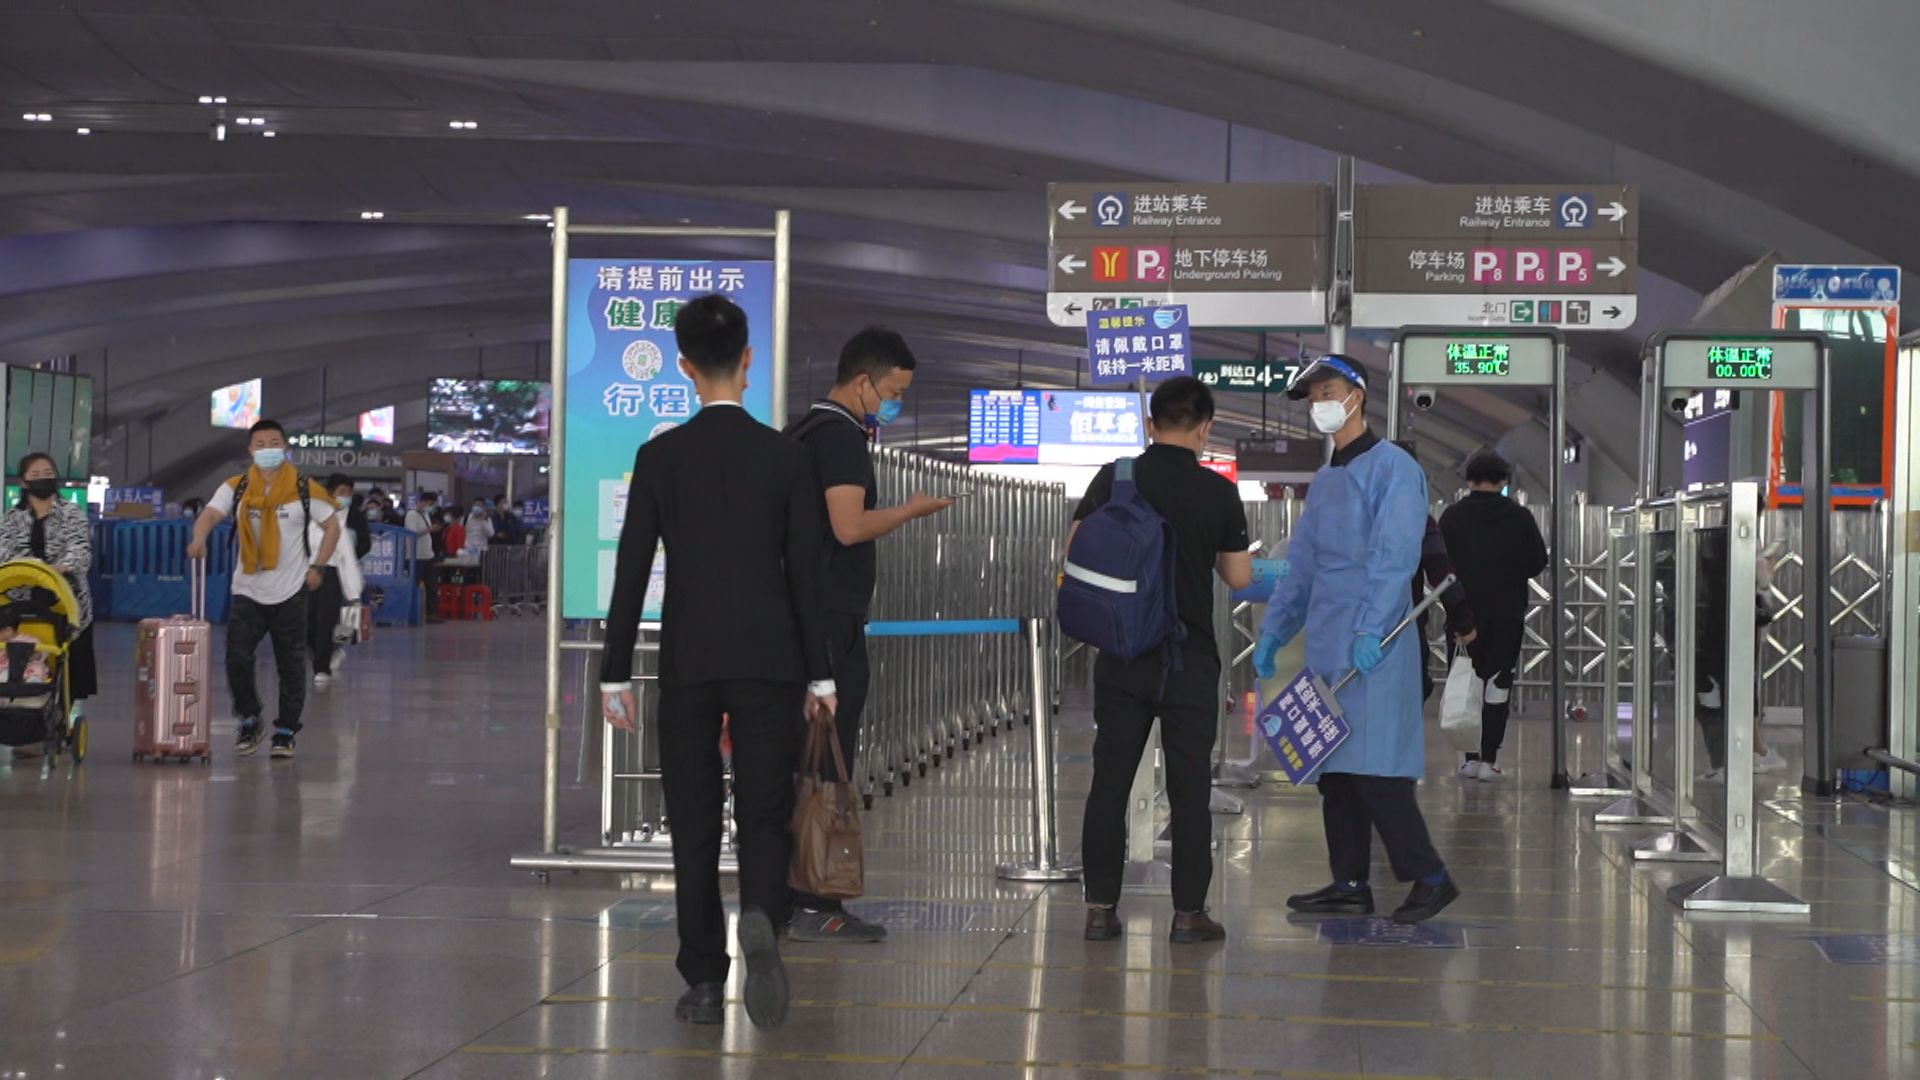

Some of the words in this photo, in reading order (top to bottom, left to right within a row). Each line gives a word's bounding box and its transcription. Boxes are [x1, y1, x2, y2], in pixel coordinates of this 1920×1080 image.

[1133, 194, 1208, 213] 进站乘车
[1475, 196, 1551, 215] 进站乘车
[1133, 215, 1173, 227] Railway
[1176, 215, 1221, 225] Entrance
[1459, 216, 1500, 229] Railway
[1503, 217, 1550, 227] Entrance
[1174, 248, 1268, 267] 地下停车场
[1409, 250, 1465, 269] 停车场
[597, 266, 745, 291] 请提前出示
[1174, 270, 1240, 281] Underground
[1243, 270, 1282, 281] Parking
[1425, 271, 1465, 283] Parking
[604, 296, 690, 330] 健康
[1481, 302, 1506, 314] 北门
[1095, 333, 1184, 355] 请佩戴口罩
[1446, 343, 1509, 361] 体温正常
[1708, 346, 1773, 364] 体温正常
[1097, 354, 1185, 376] 保持一米距离
[1256, 364, 1300, 389] 4-7
[603, 382, 704, 418] 行程
